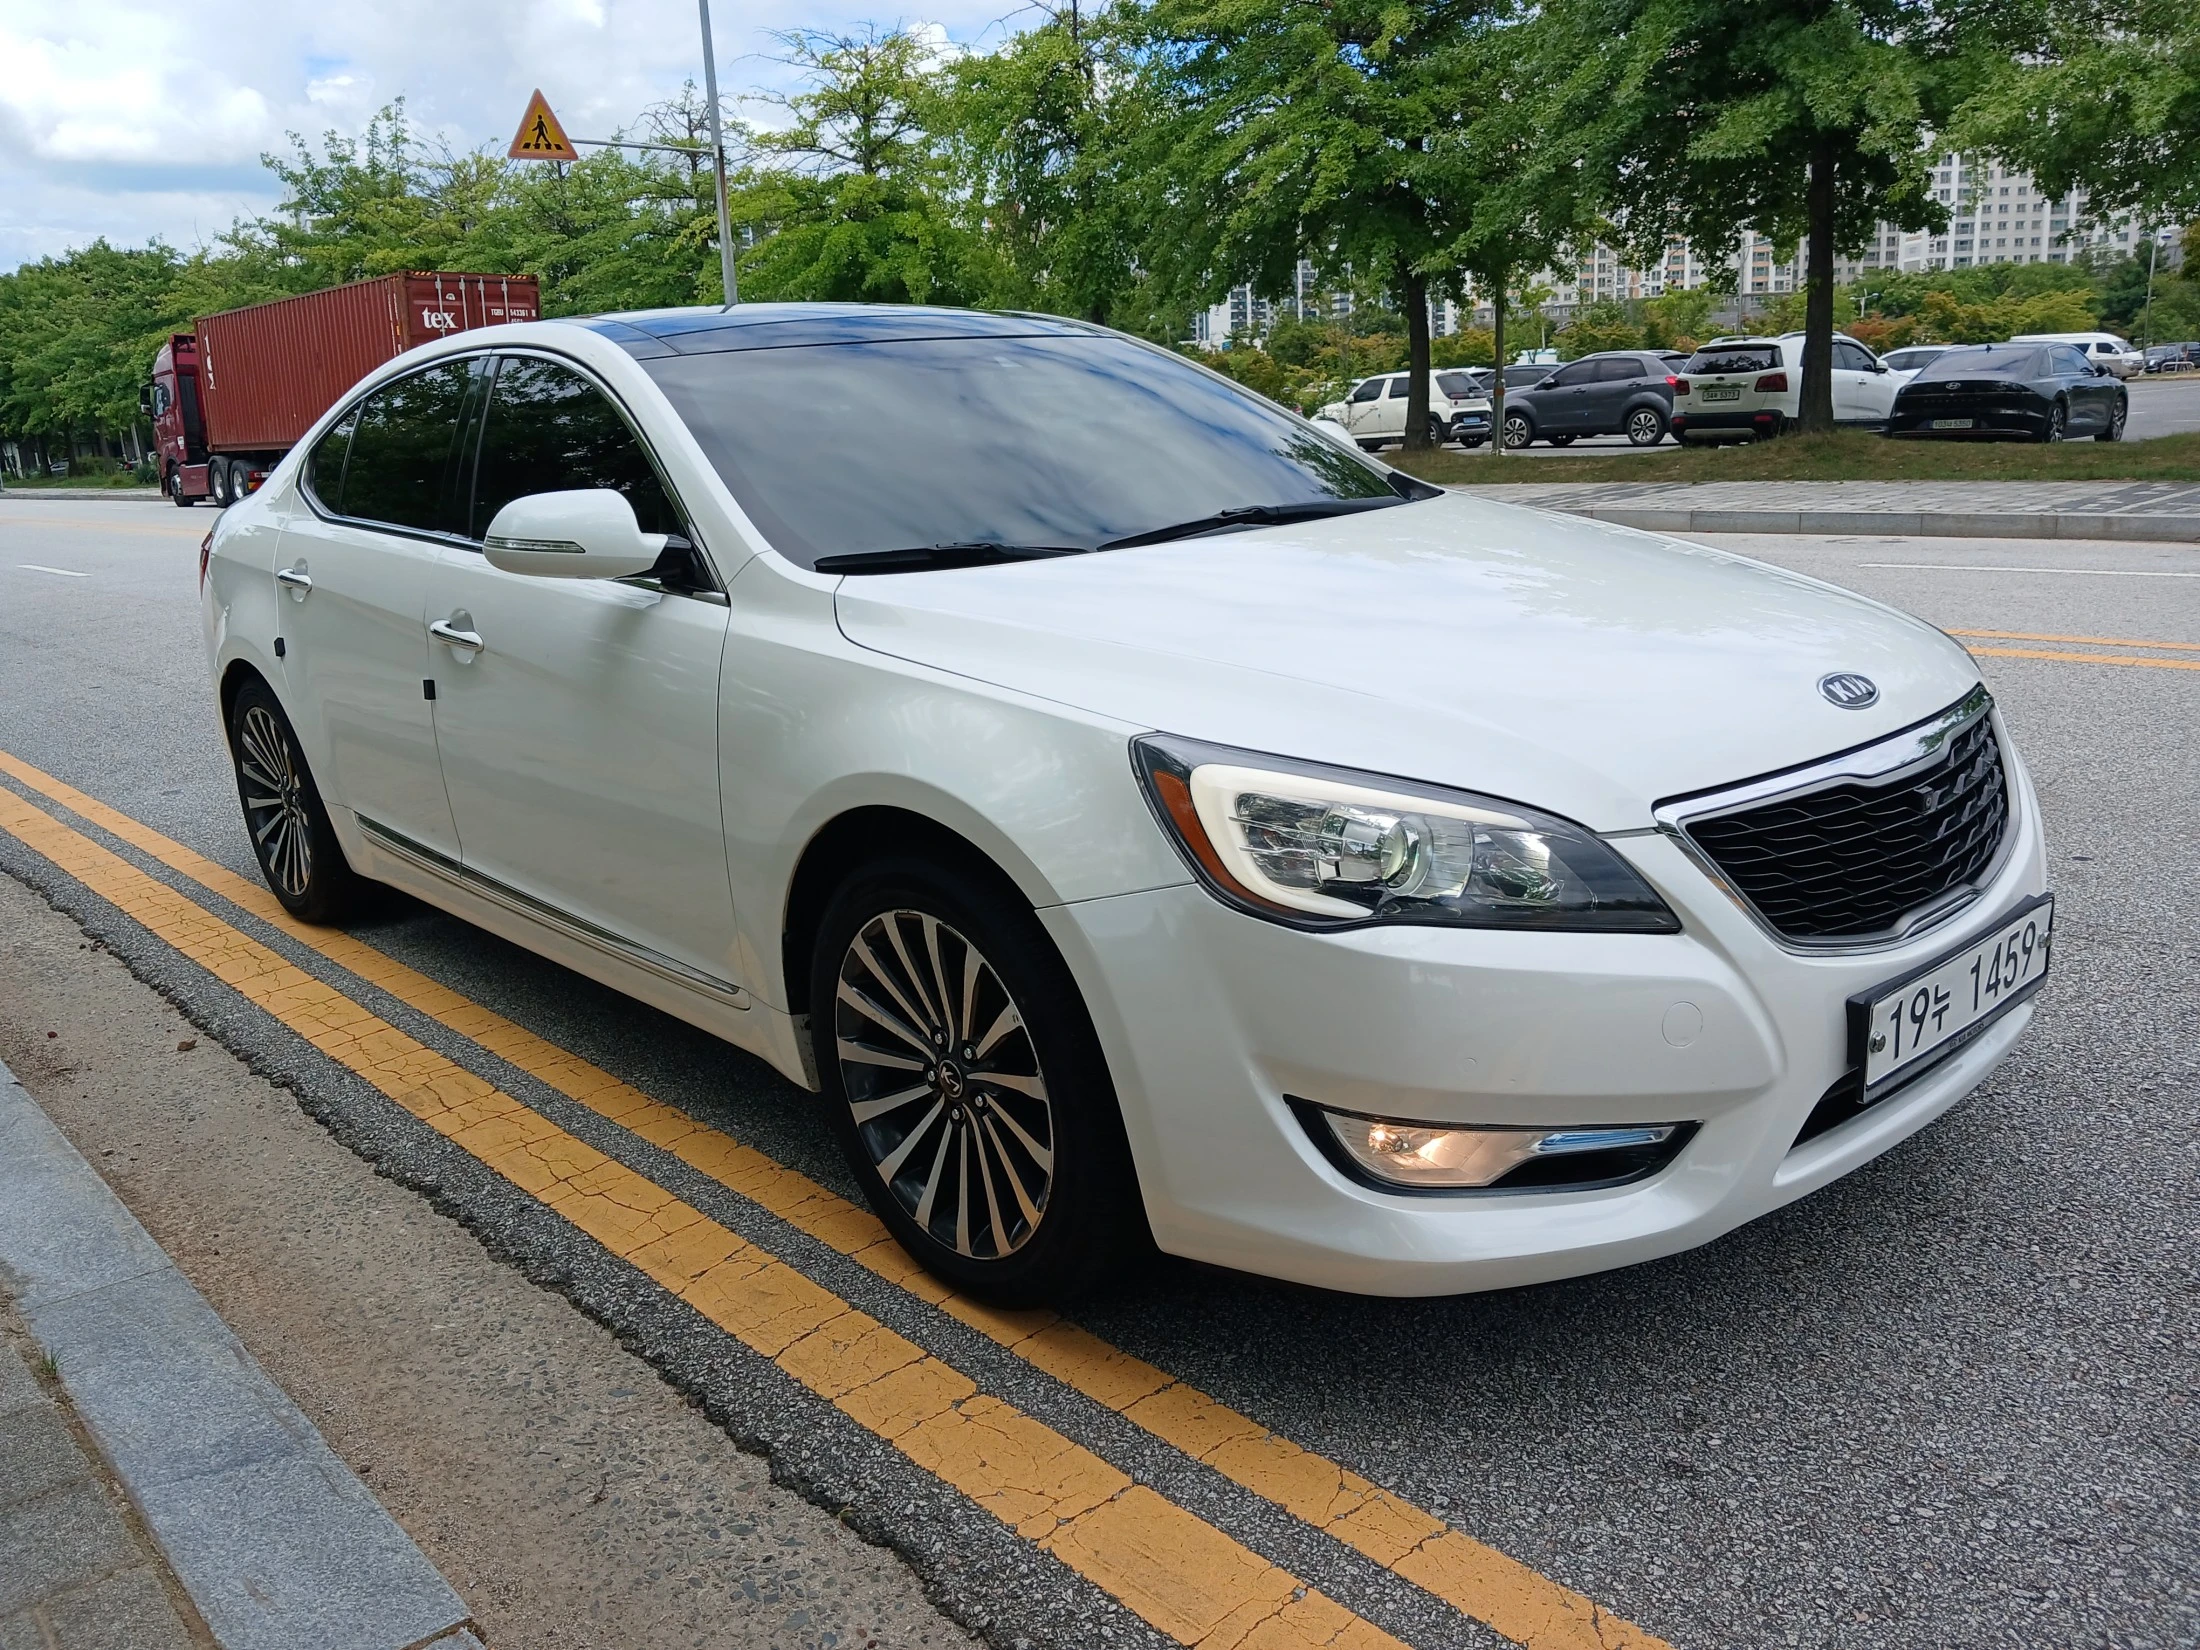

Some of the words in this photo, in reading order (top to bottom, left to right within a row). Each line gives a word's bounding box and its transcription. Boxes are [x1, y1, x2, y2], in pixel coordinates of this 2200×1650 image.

[422, 306, 458, 329] tex
[1826, 675, 1874, 702] KIA
[1889, 984, 1951, 1060] 19누
[1970, 920, 2036, 1012] 1459
